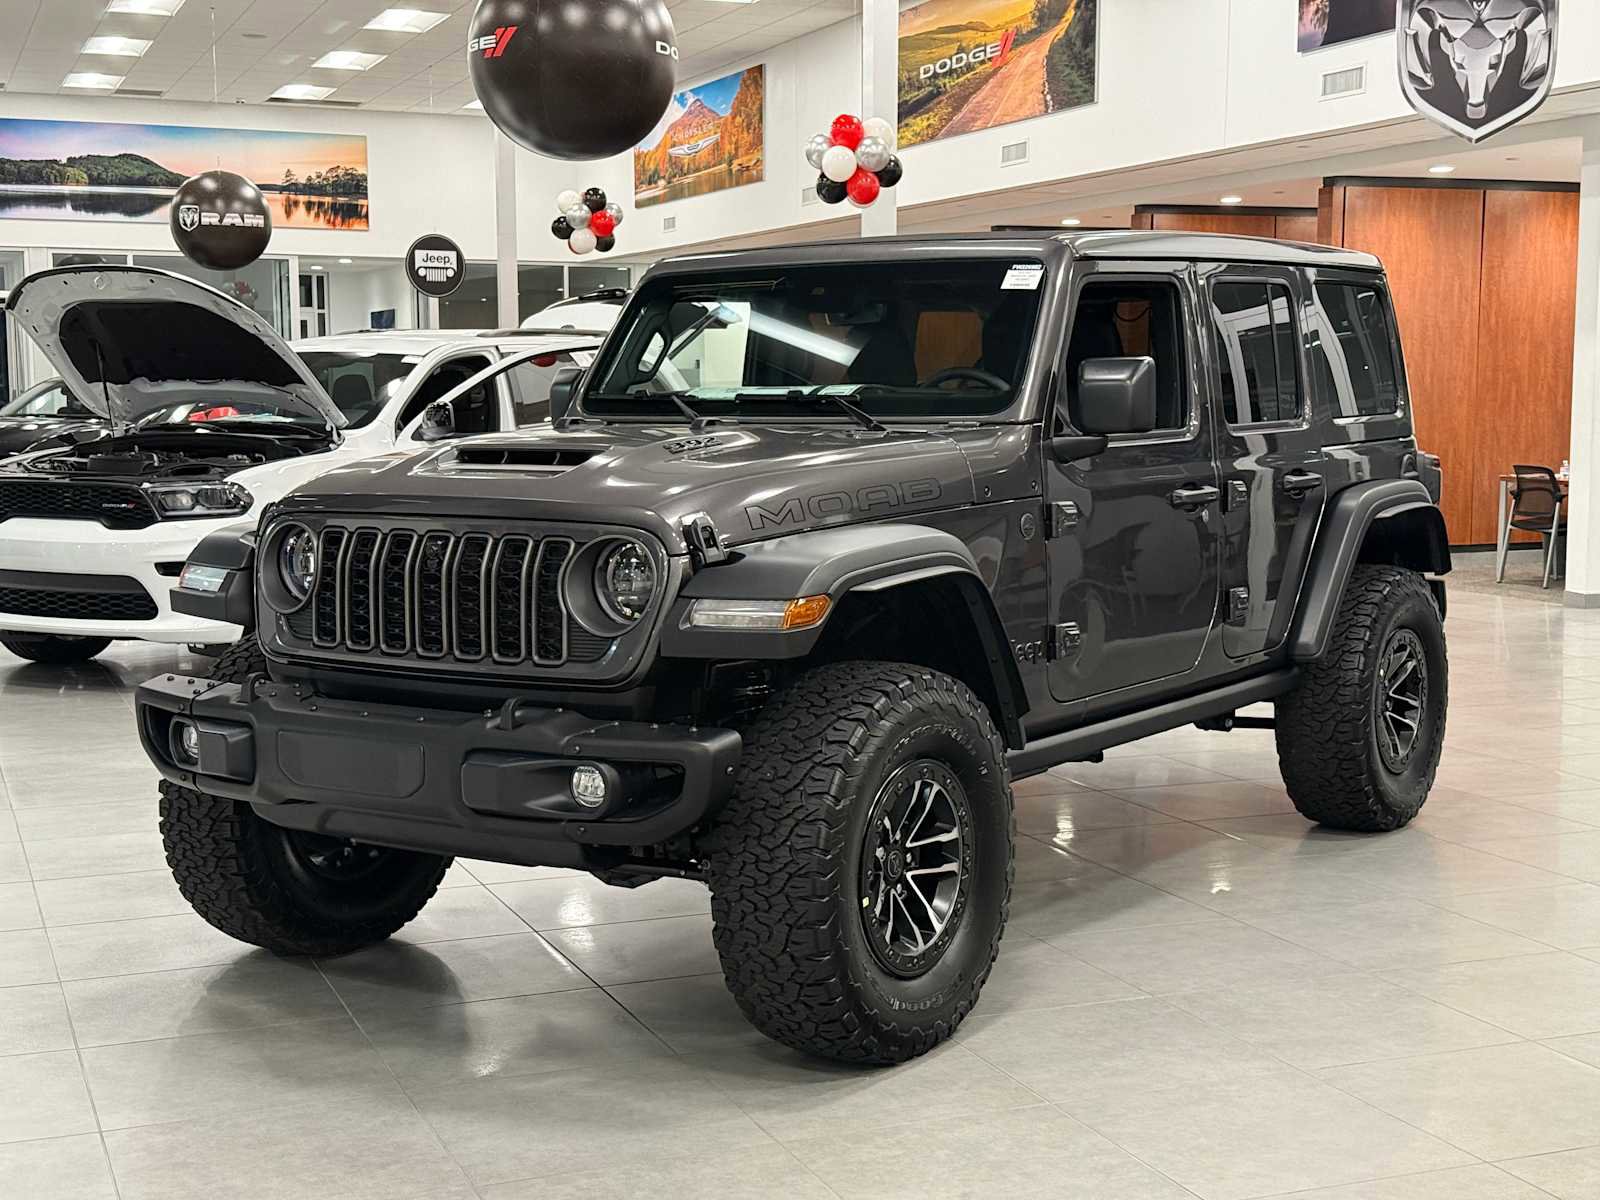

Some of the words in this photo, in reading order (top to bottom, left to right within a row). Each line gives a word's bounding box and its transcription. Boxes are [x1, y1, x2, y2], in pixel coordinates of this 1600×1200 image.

[919, 42, 1002, 79] DODGE
[200, 212, 265, 228] RAM
[422, 252, 451, 265] Jeep
[744, 477, 943, 530] MOAB
